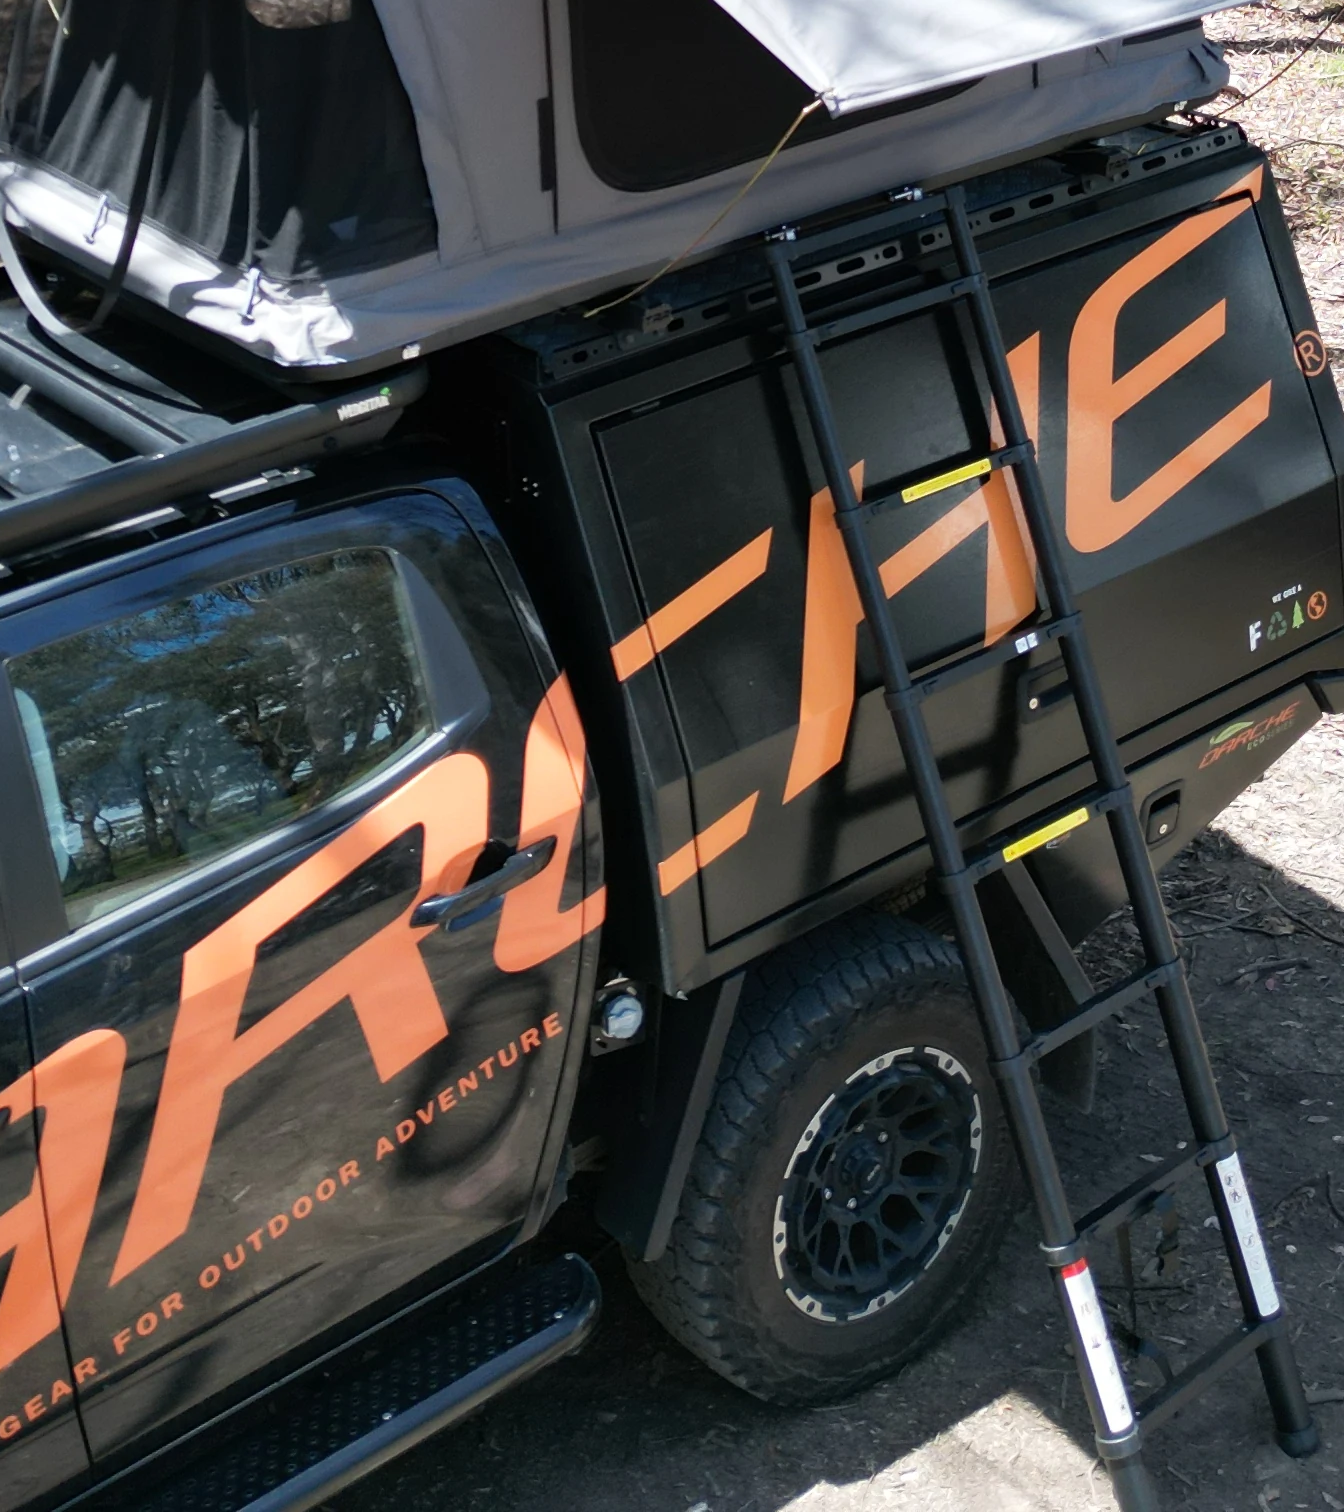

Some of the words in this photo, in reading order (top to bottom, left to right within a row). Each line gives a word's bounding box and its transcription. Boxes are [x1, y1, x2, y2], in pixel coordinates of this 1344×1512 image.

[113, 1293, 184, 1354] FOR
[199, 1160, 360, 1289] OUTDOOR
[376, 1013, 563, 1160] ADVENTURE
